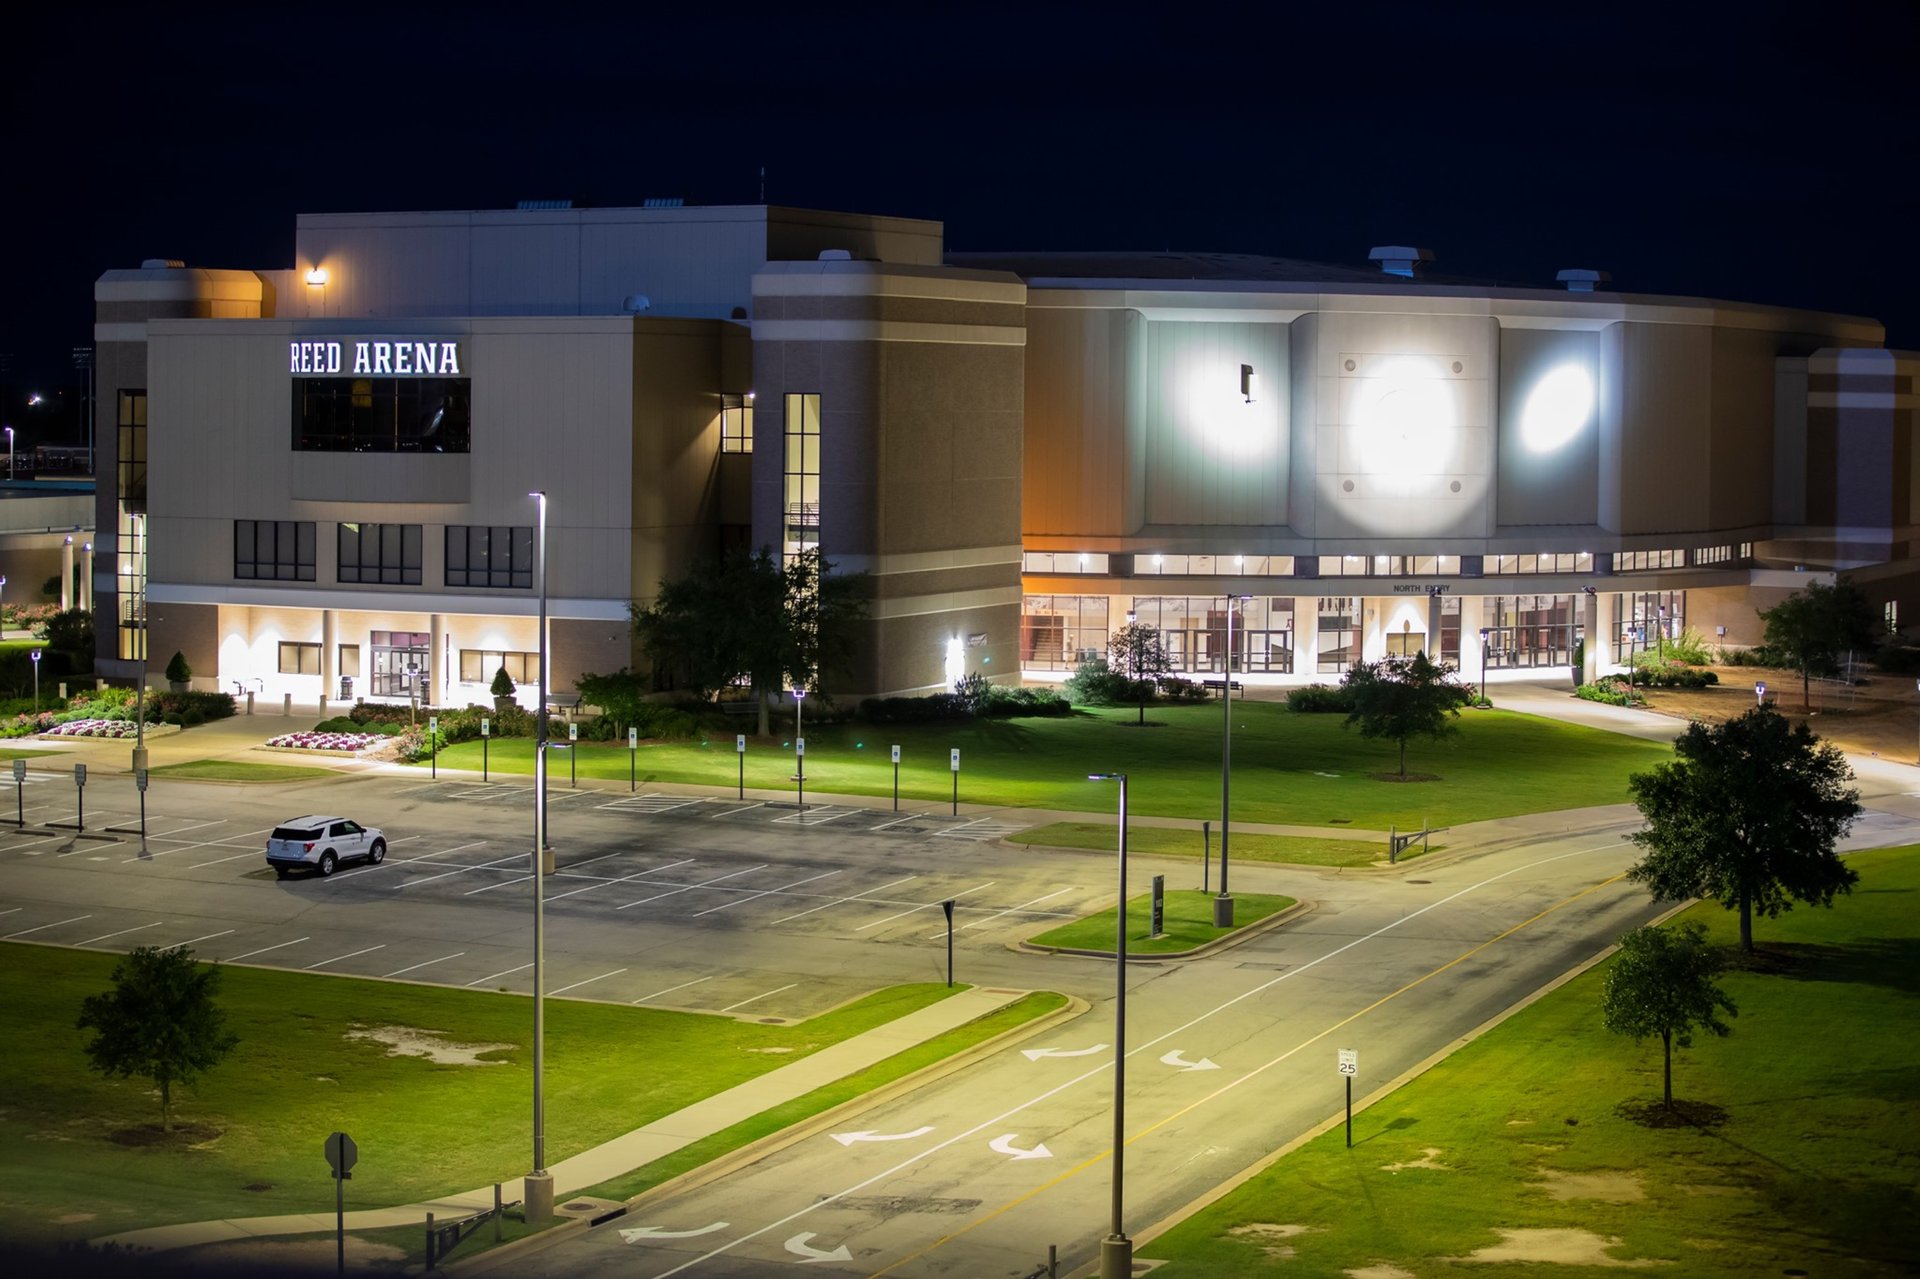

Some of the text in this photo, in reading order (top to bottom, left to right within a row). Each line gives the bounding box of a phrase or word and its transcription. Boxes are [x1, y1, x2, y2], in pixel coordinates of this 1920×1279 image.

[290, 342, 460, 374] REED ARENA
[1393, 584, 1421, 593] NORTH
[1340, 1063, 1356, 1074] 25
